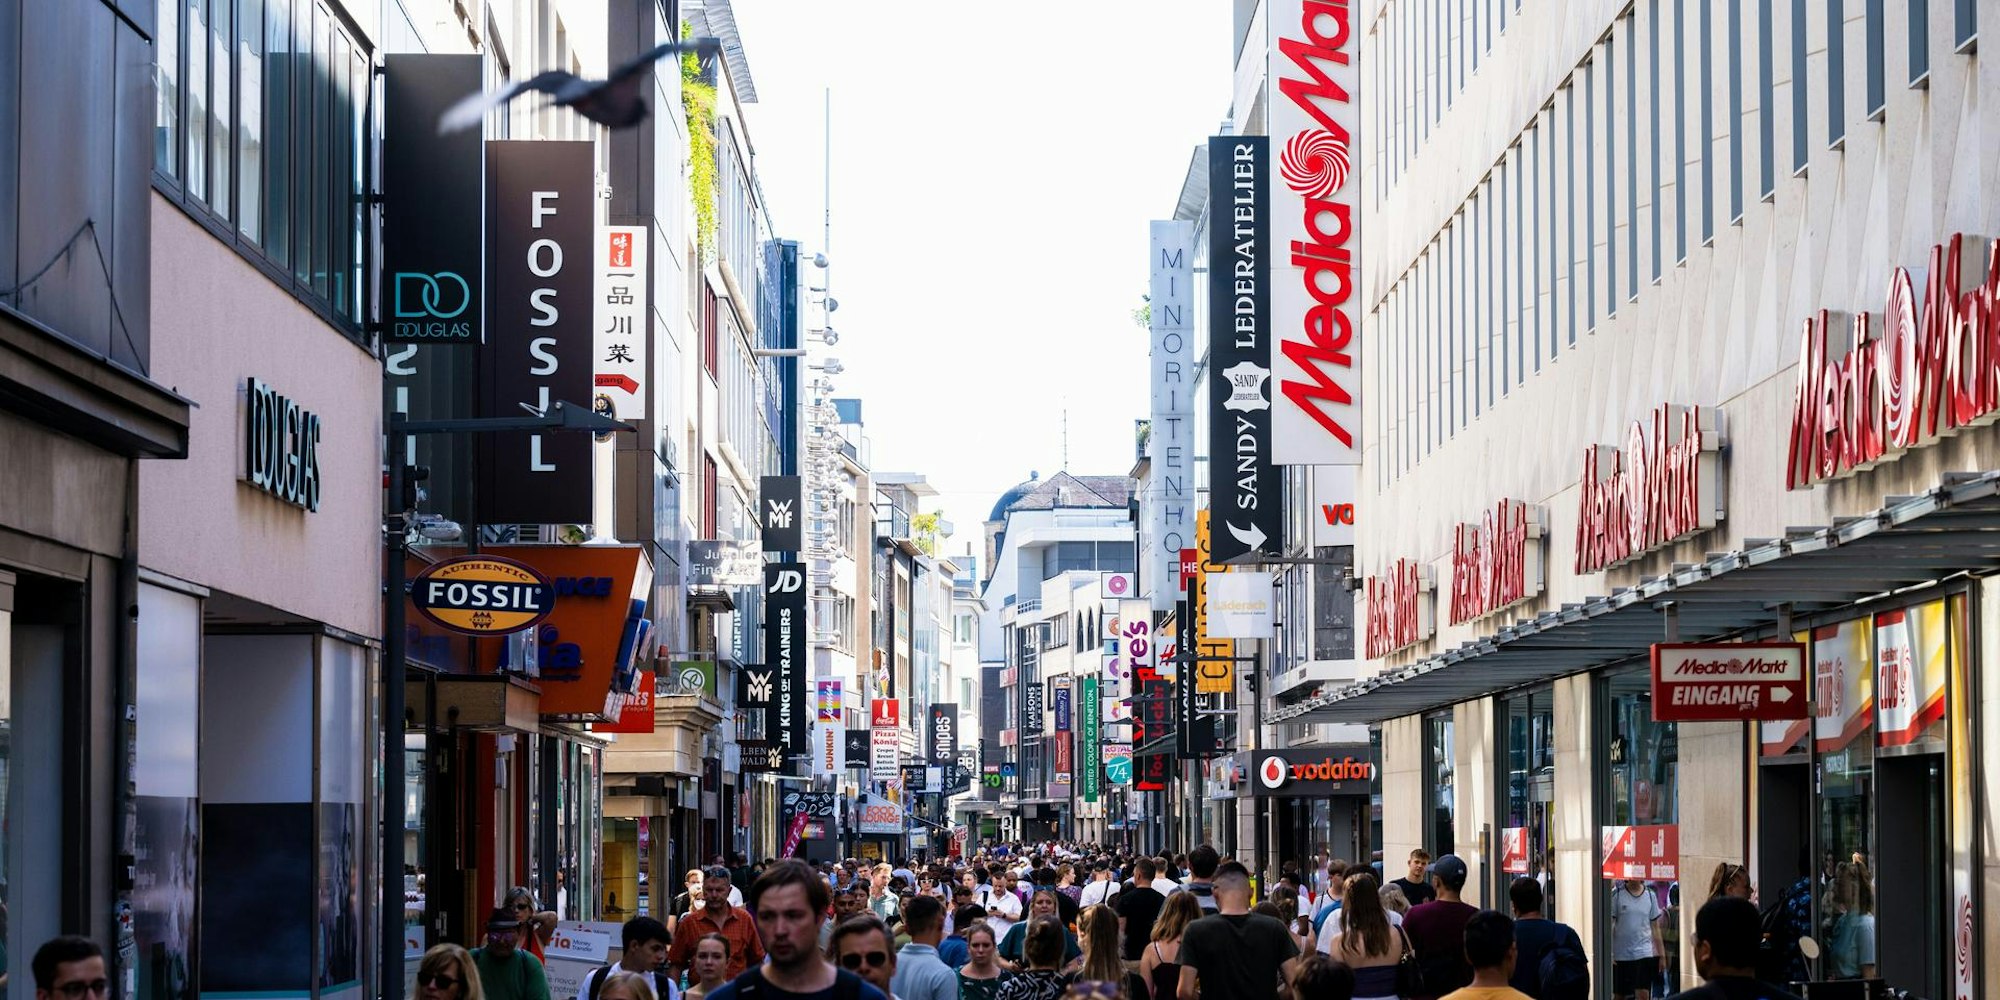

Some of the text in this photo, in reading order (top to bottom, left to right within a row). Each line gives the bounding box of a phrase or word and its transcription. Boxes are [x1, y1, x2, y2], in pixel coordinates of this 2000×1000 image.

[1278, 0, 1352, 449] Media Ma
[1233, 143, 1255, 349] LEDERATELIER
[395, 323, 470, 337] DOUGLAS
[527, 191, 563, 472] FOSSIL
[605, 273, 635, 363] 一品川菜
[1234, 373, 1259, 388] SANDY
[1786, 308, 1887, 491] Media
[1162, 247, 1183, 583] MINORITENHOF
[247, 377, 321, 513] DOUGLAS
[1236, 416, 1259, 510] SANDY
[1575, 402, 1702, 576] Media Markt
[768, 499, 793, 528] WMF
[1322, 503, 1354, 526] vo
[441, 563, 529, 581] AUTHENTIC
[692, 563, 723, 576] Fine
[769, 570, 802, 594] JD
[428, 582, 540, 609] FOSSIL
[781, 607, 791, 727] KING OF TRAINERS
[1674, 658, 1788, 675] Media Markt
[747, 670, 773, 702] WMF
[1058, 689, 1067, 701] 73
[1671, 685, 1761, 706] EINGANG
[1817, 675, 1833, 719] CLUB
[1880, 664, 1899, 710] CLUB
[1152, 685, 1165, 738] Locker
[873, 738, 898, 746] König
[1087, 726, 1094, 737] OF
[740, 757, 767, 765] WALD
[826, 728, 834, 770] DUNKIN'
[862, 814, 900, 823] LOUNGE
[866, 806, 896, 814] FOOD
[573, 939, 591, 947] Money
